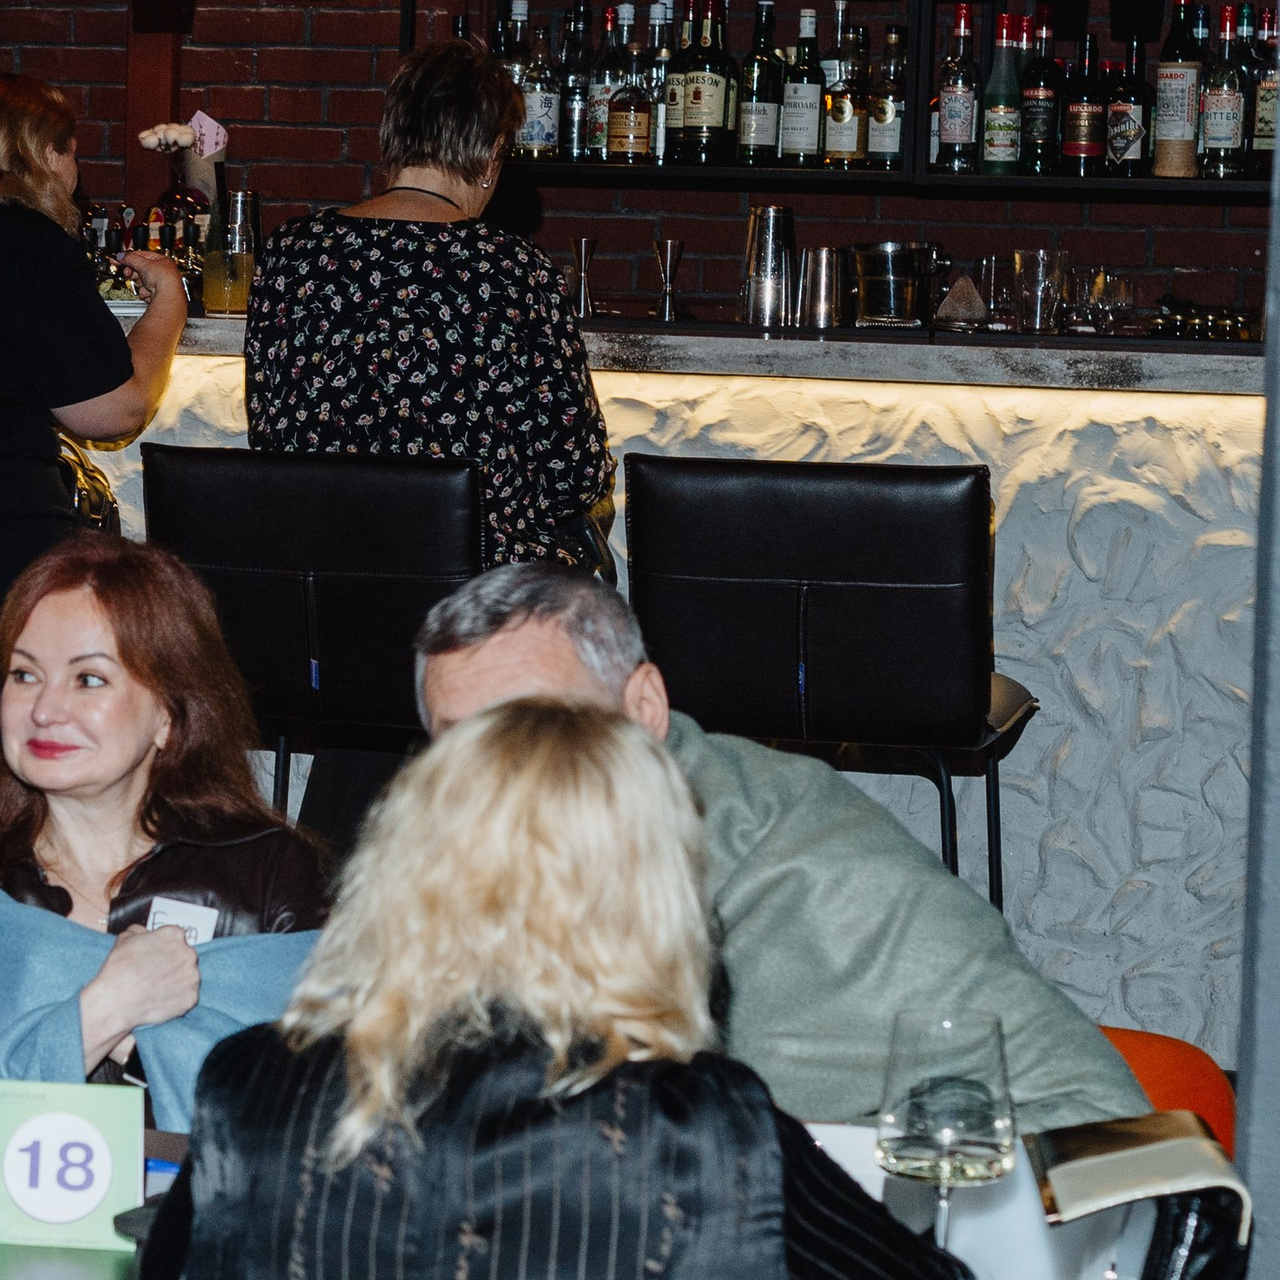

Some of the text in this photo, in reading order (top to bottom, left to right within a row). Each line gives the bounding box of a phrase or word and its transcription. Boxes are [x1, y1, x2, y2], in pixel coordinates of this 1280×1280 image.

[1023, 89, 1054, 97] LUXARDO
[535, 95, 554, 121] 海人
[1069, 104, 1104, 114] LUXARDO
[1205, 112, 1239, 122] BITTER
[18, 1139, 97, 1192] 18
